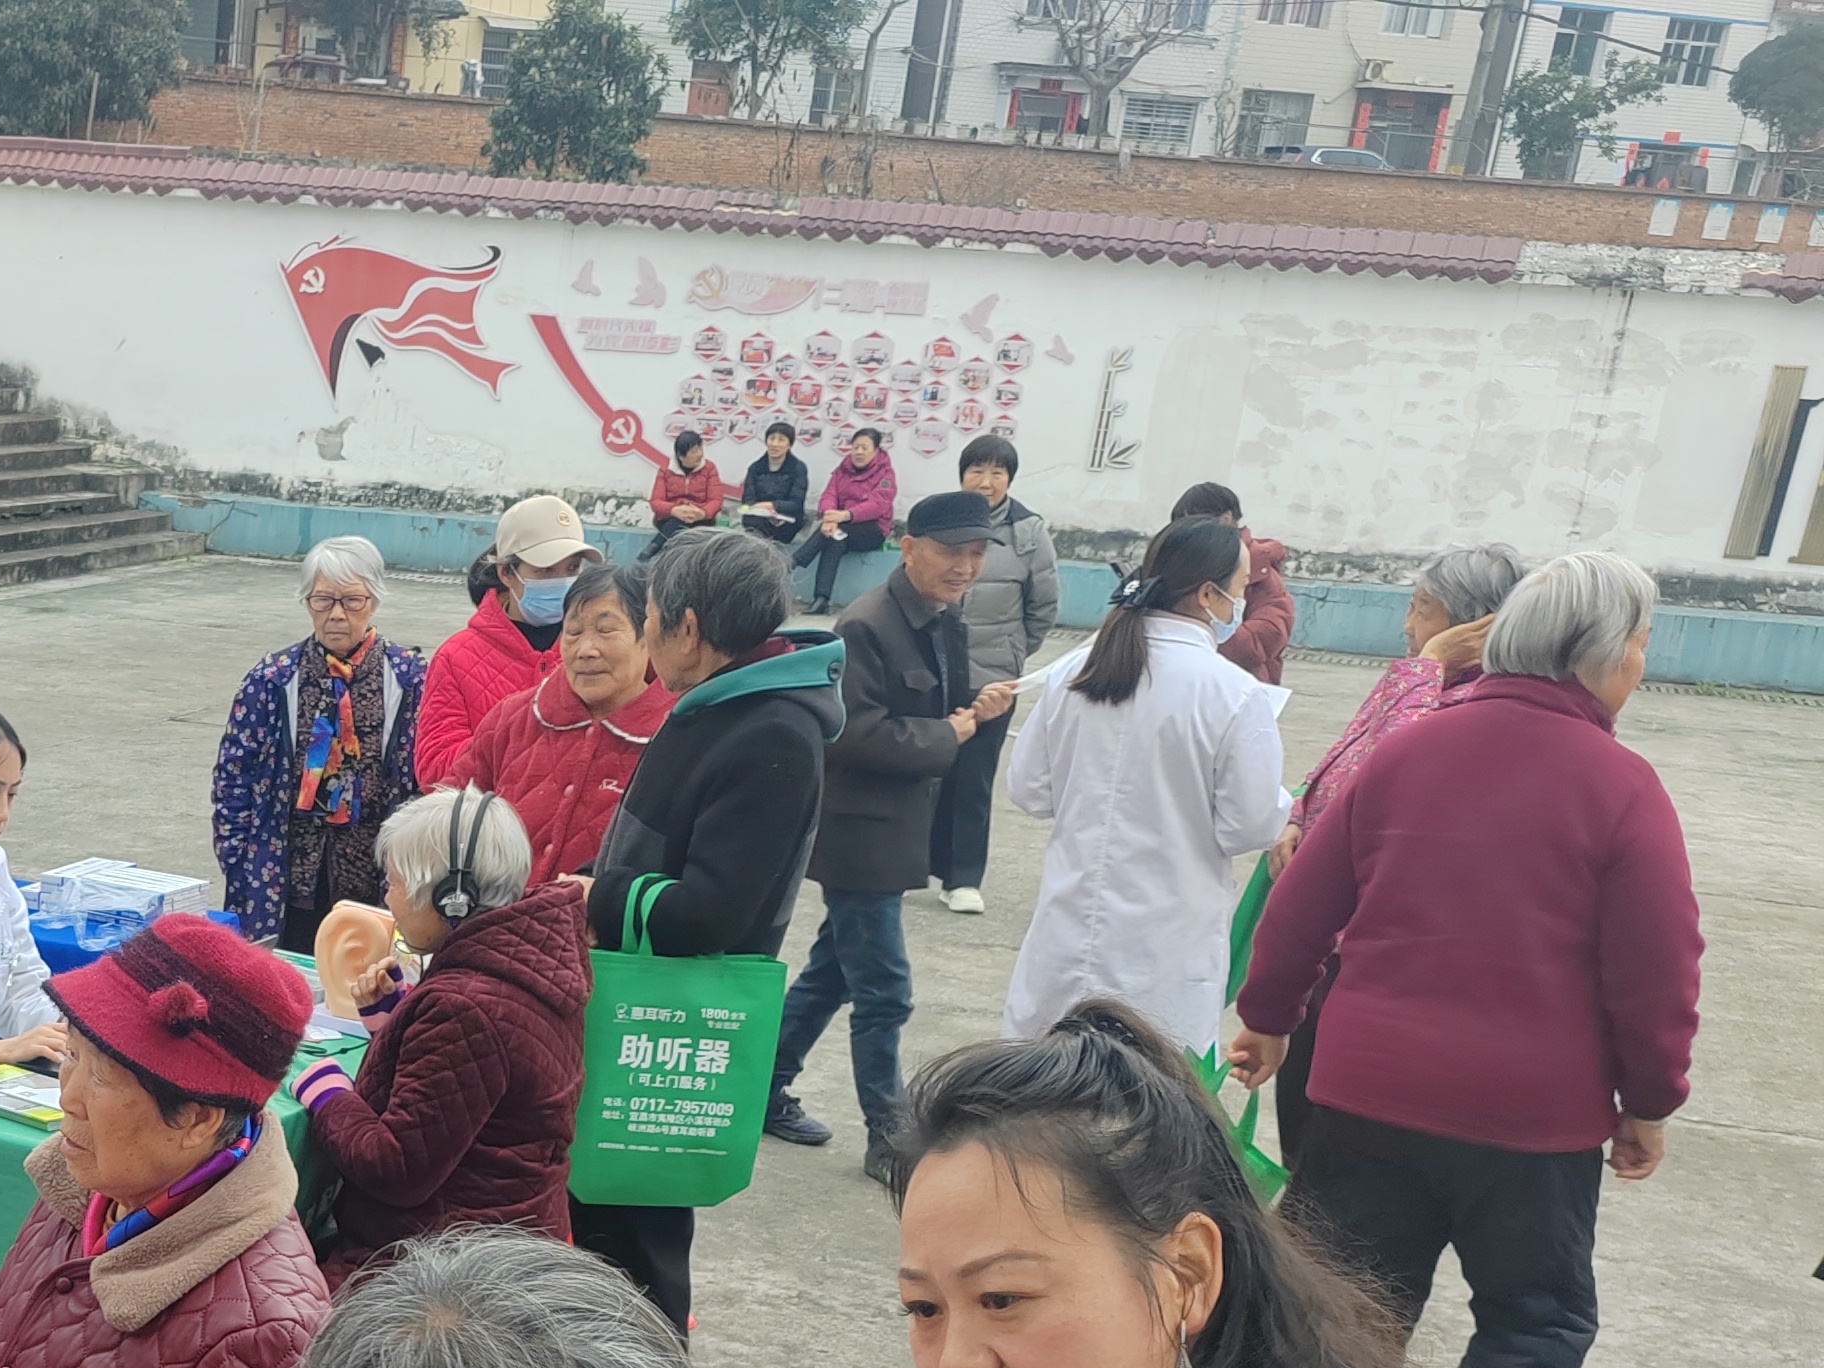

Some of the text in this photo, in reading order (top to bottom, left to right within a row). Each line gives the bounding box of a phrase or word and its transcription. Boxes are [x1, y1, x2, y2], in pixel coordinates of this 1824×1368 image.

[630, 1006, 686, 1024] 惠耳听力
[617, 1033, 731, 1074] 助听器
